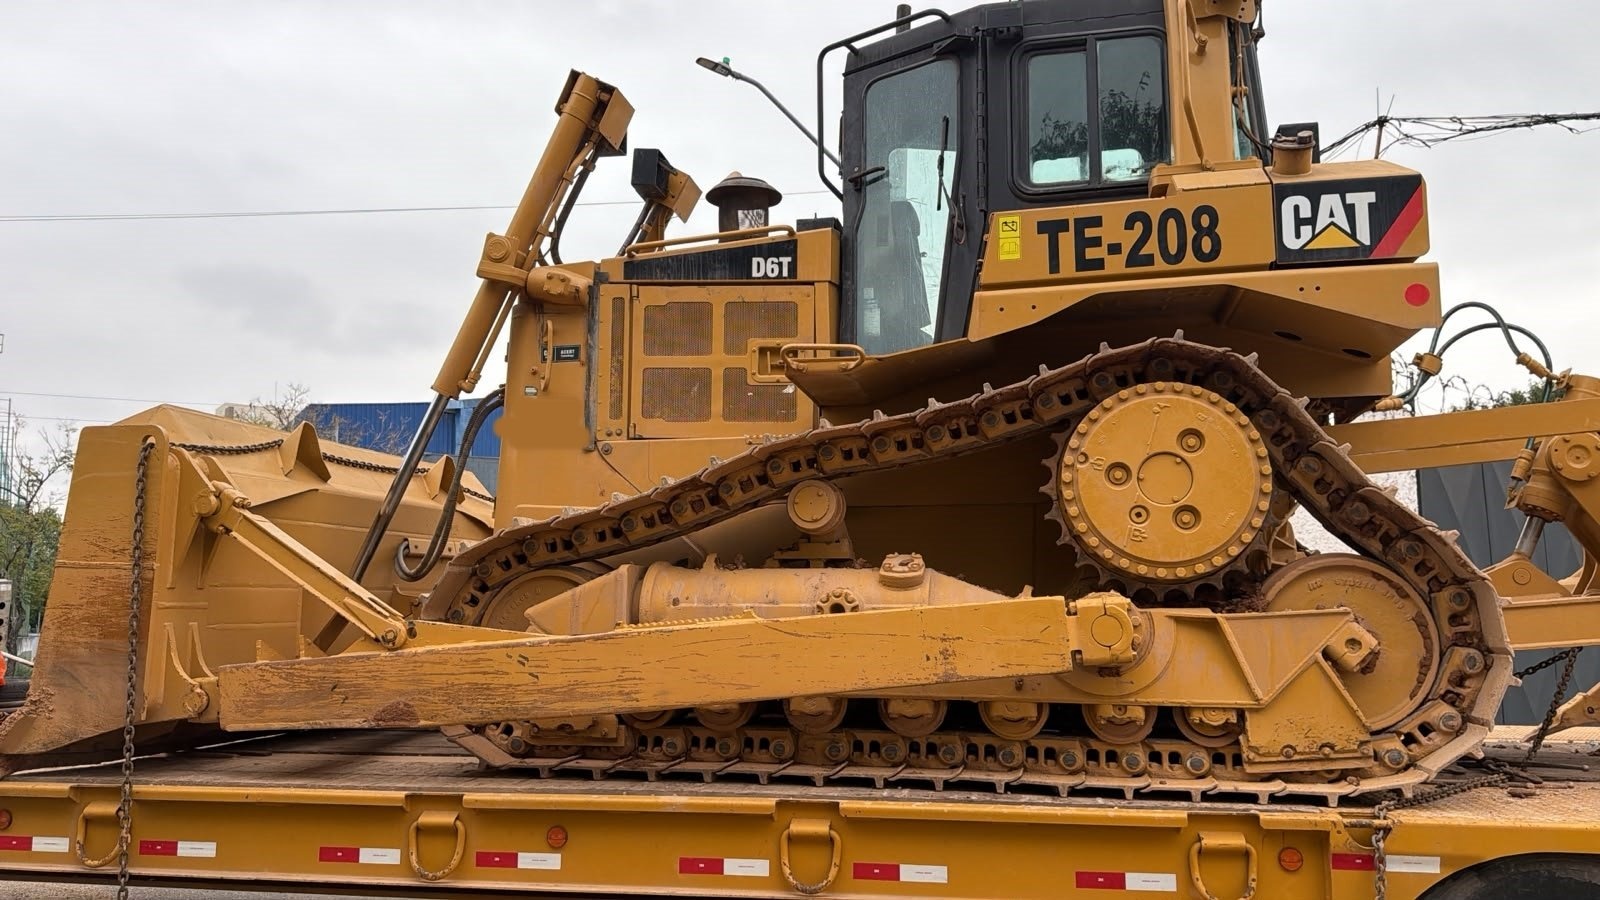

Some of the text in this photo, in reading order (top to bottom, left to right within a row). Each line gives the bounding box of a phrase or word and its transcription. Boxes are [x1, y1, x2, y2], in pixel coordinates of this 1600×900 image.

[1037, 205, 1222, 275] TE-208
[1281, 191, 1376, 250] CAT
[752, 257, 792, 278] D6T
